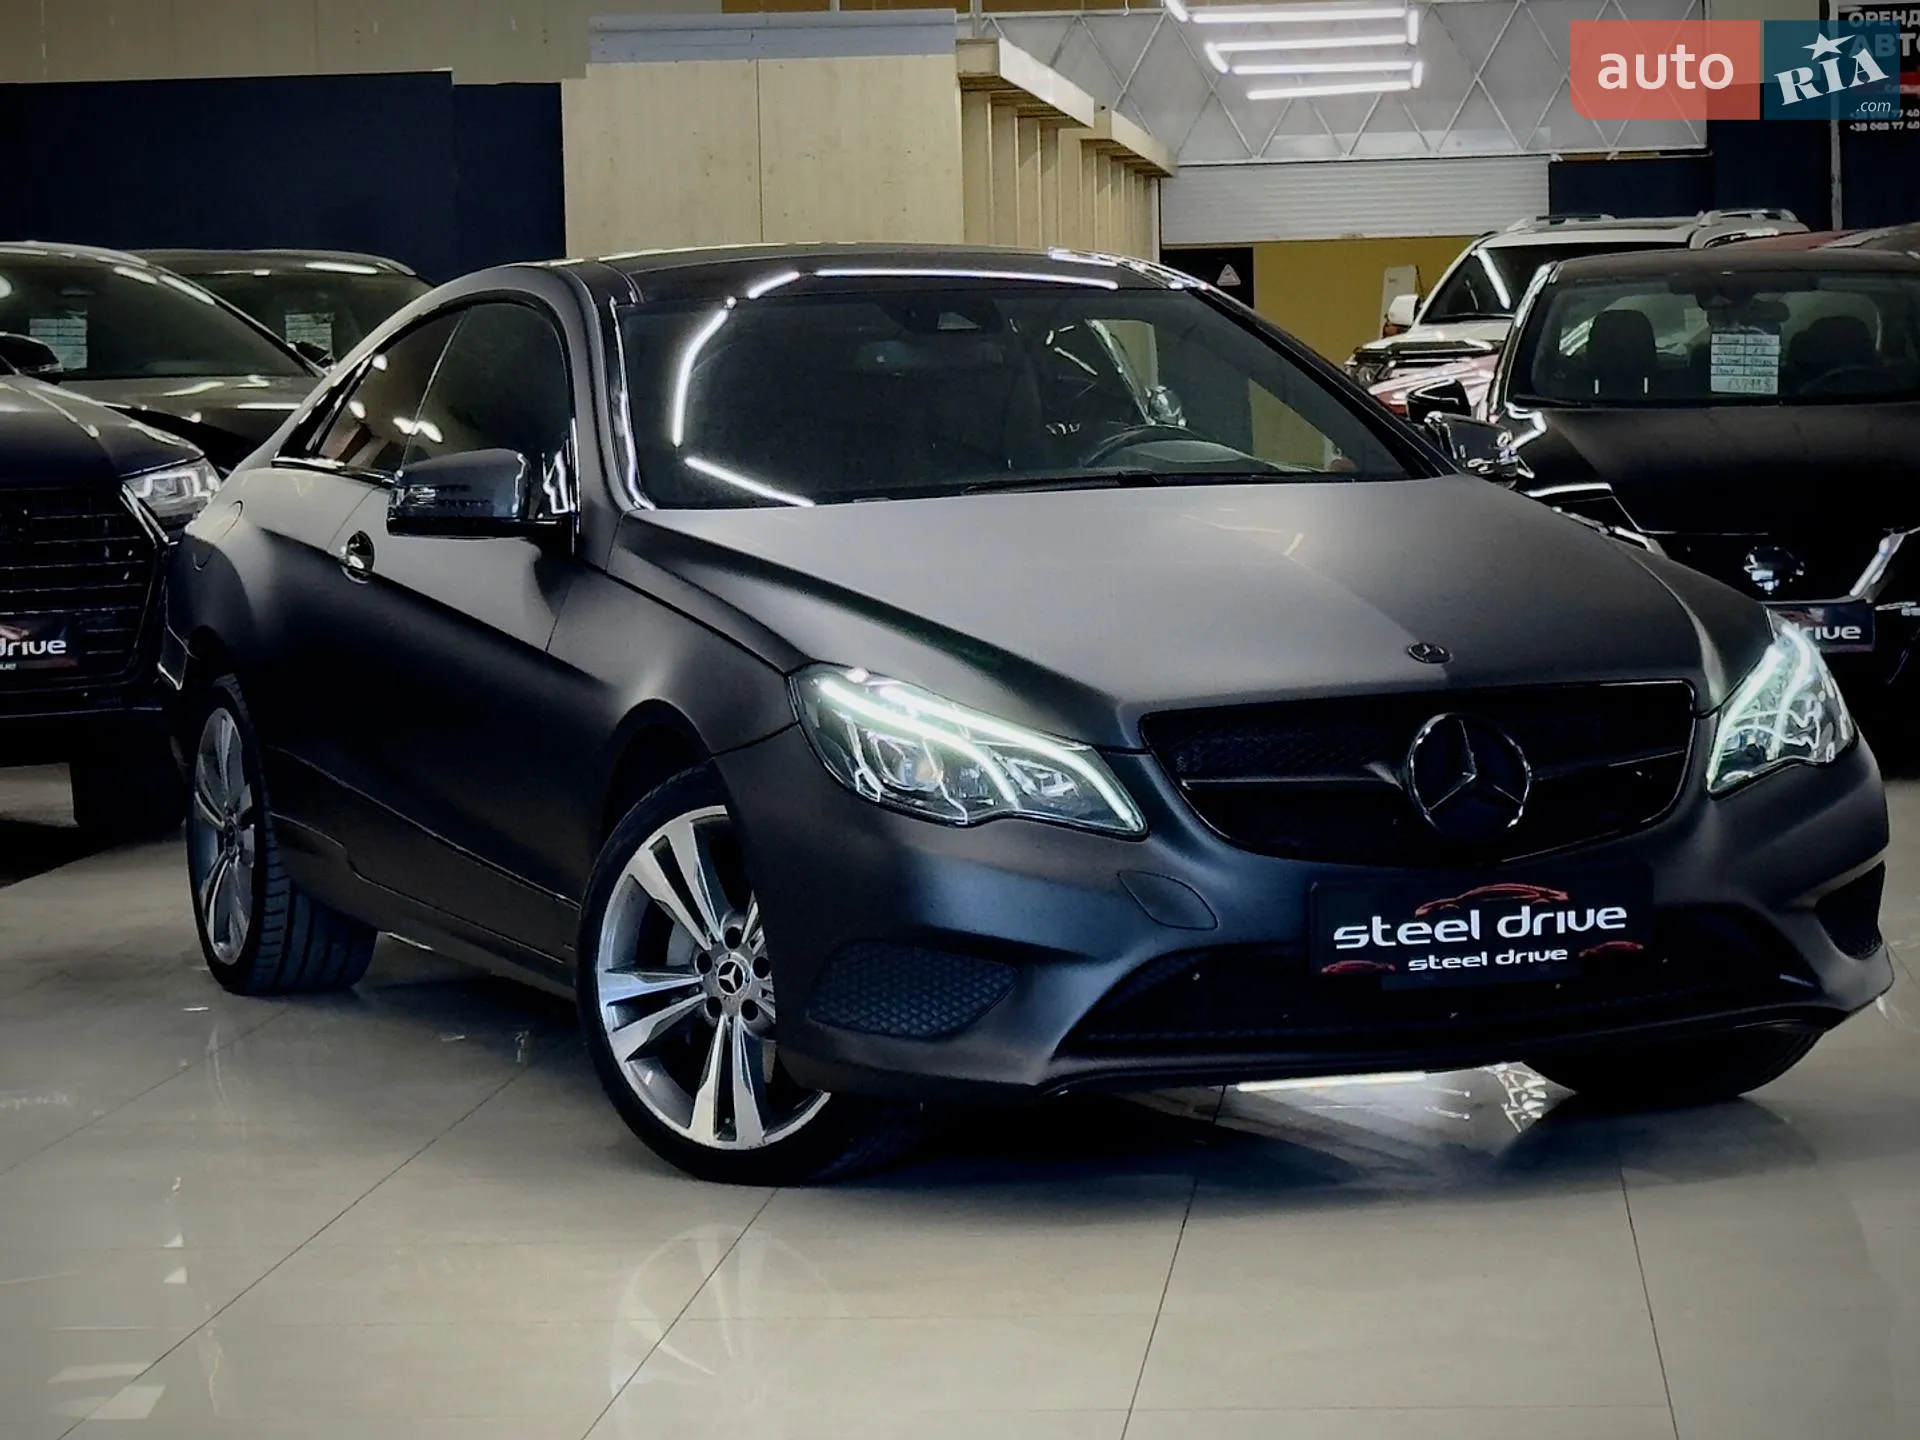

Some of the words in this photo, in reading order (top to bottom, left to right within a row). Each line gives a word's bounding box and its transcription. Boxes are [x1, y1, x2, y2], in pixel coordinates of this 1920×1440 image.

[1847, 32, 1920, 58] АВТ
[1799, 624, 1862, 640] rive
[1333, 908, 1481, 950] steel
[1496, 905, 1628, 939] drive
[1408, 951, 1488, 972] steel
[1494, 948, 1568, 966] drive
